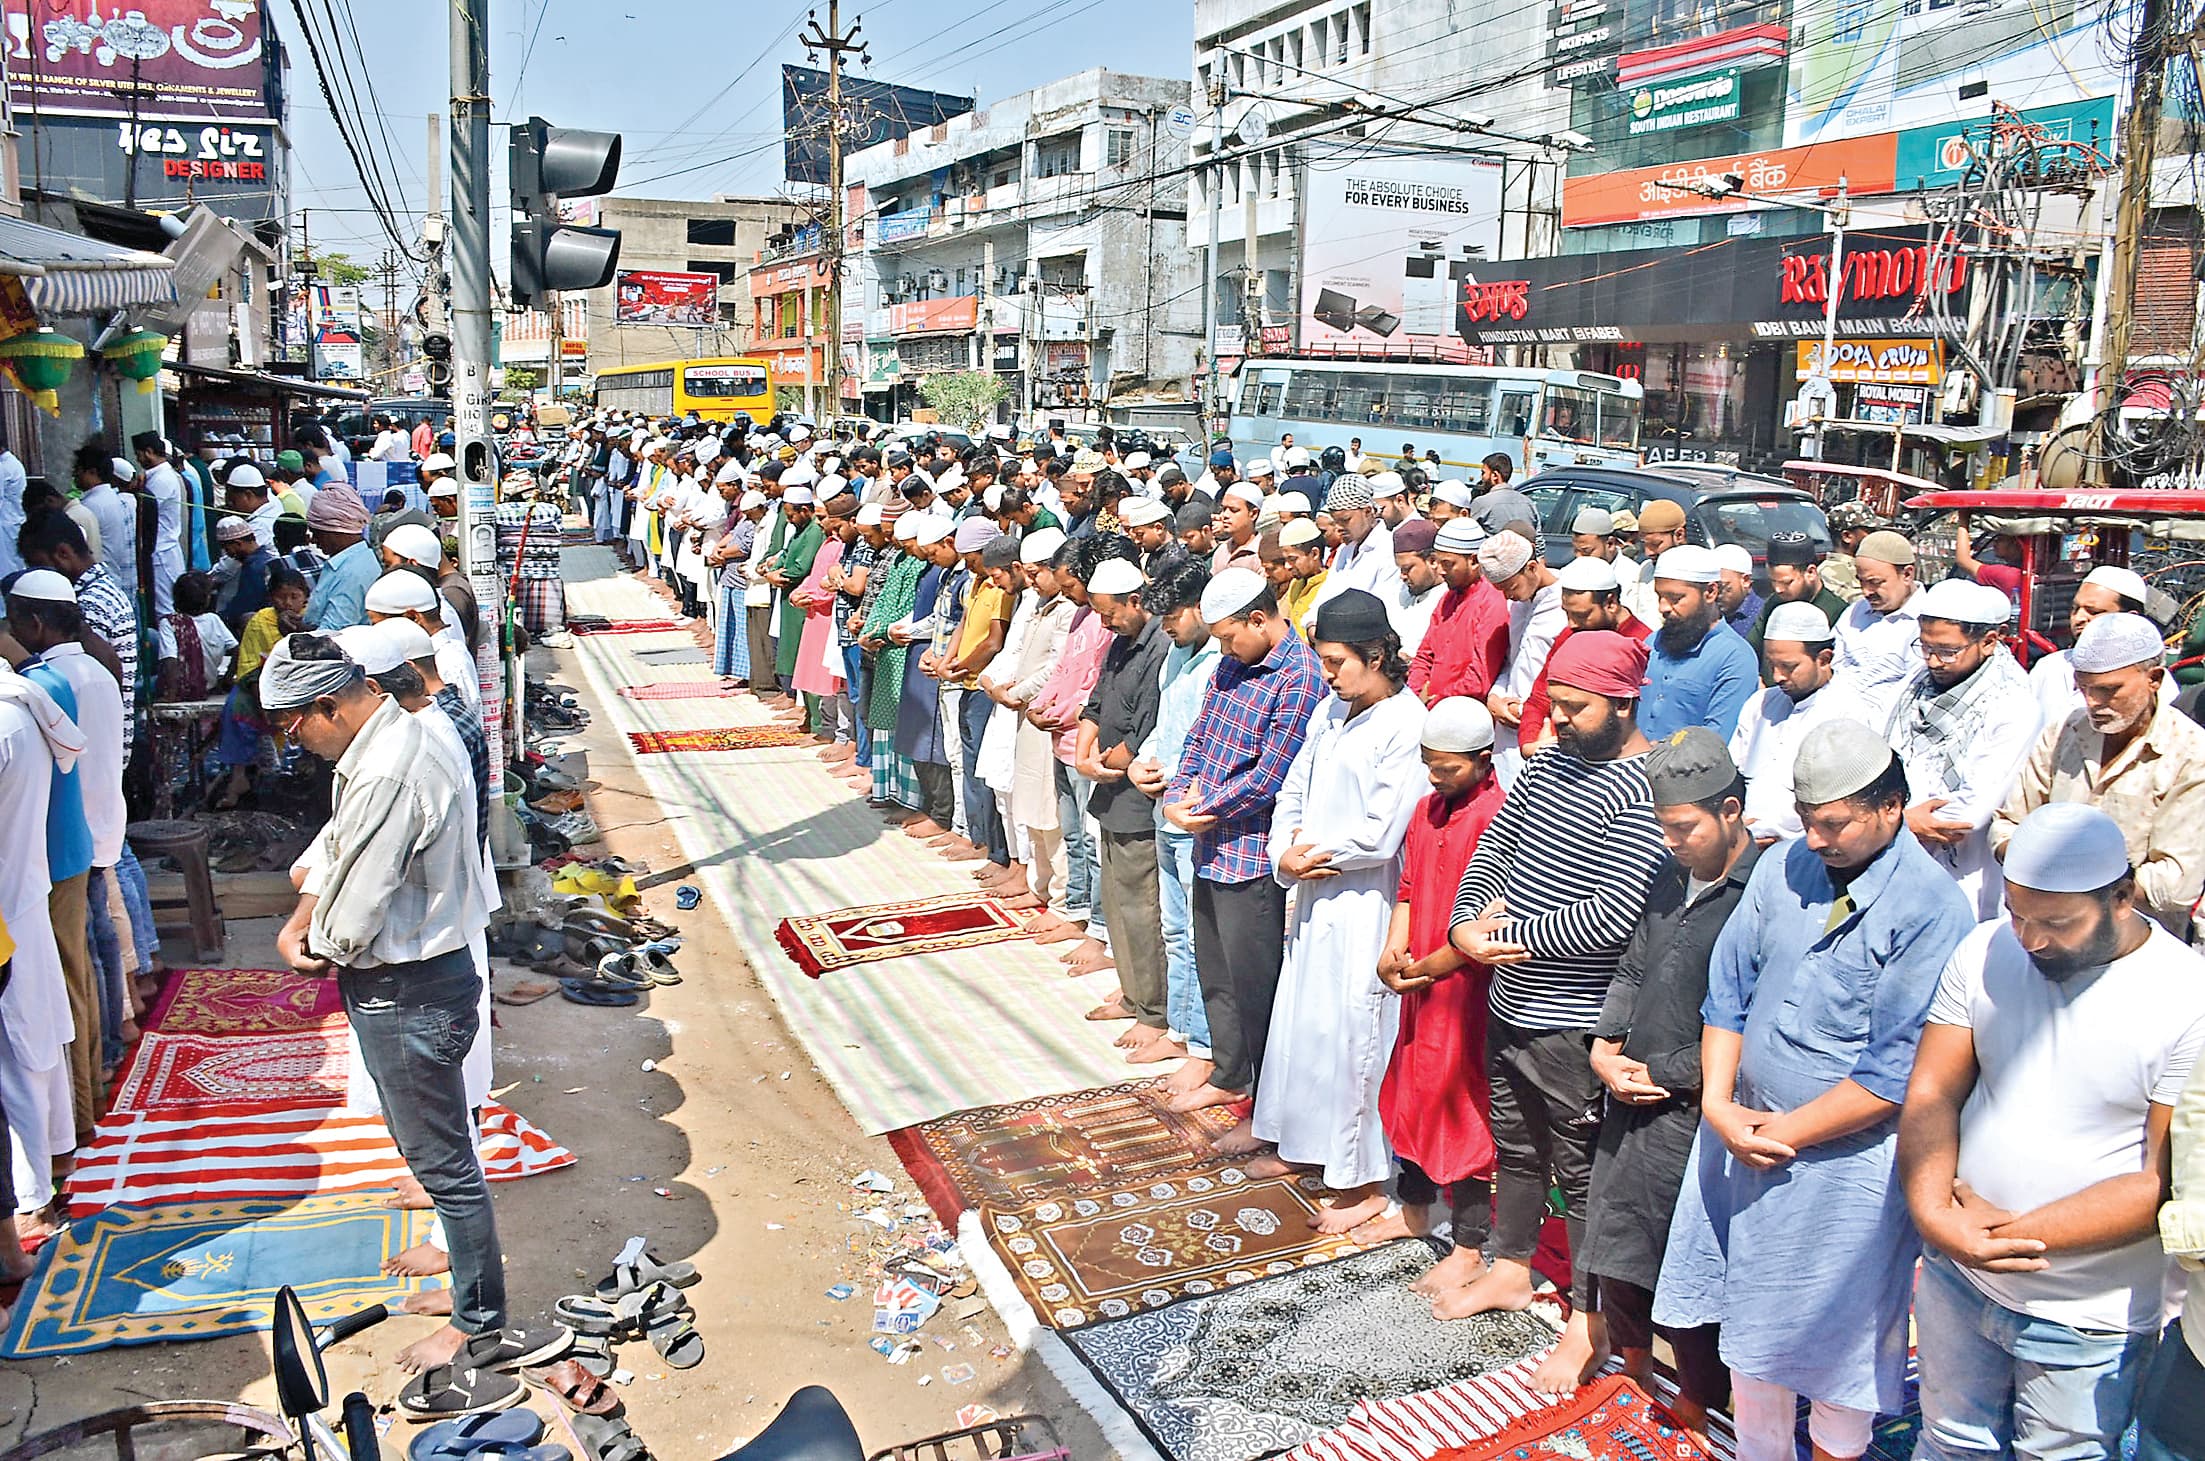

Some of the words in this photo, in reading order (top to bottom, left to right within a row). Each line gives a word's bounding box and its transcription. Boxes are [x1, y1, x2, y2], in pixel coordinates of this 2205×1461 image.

[1556, 27, 1610, 52] ARTIFACTS
[1556, 58, 1609, 81] LIFESTYLE
[19, 73, 40, 83] WIE
[43, 75, 74, 85] RANGE
[75, 77, 88, 86] OF
[89, 79, 116, 89] SILVER
[208, 86, 214, 95] &
[215, 86, 257, 97] JEWELLERY
[1629, 118, 1656, 134] SOUTH
[1657, 112, 1683, 130] INDIAN
[1684, 103, 1738, 125] RESTAURANT
[1846, 104, 1887, 118] DHALAI
[1846, 113, 1887, 126] EXPERT
[118, 122, 188, 156] Yes
[197, 126, 264, 160] Sir
[163, 159, 266, 179] DESIGNER
[1471, 158, 1502, 169] Canon
[1749, 157, 1787, 189] बैंक
[1346, 179, 1367, 192] THE
[1369, 181, 1423, 197] ABSOLUTE
[1425, 185, 1463, 201] CHOICE
[1345, 191, 1369, 205] FOR
[1371, 194, 1410, 209] EVERY
[1412, 198, 1469, 214] BUSINESS
[1477, 329, 1538, 343] HINDUSTAN
[1538, 327, 1570, 341] MART
[1585, 326, 1624, 340] FABER
[1754, 320, 1788, 337] IDBI
[1840, 318, 1886, 334] MAIN
[1878, 345, 1929, 370] CRUSH
[1859, 384, 1887, 400] ROYAL
[1888, 387, 1923, 403] MOBILE
